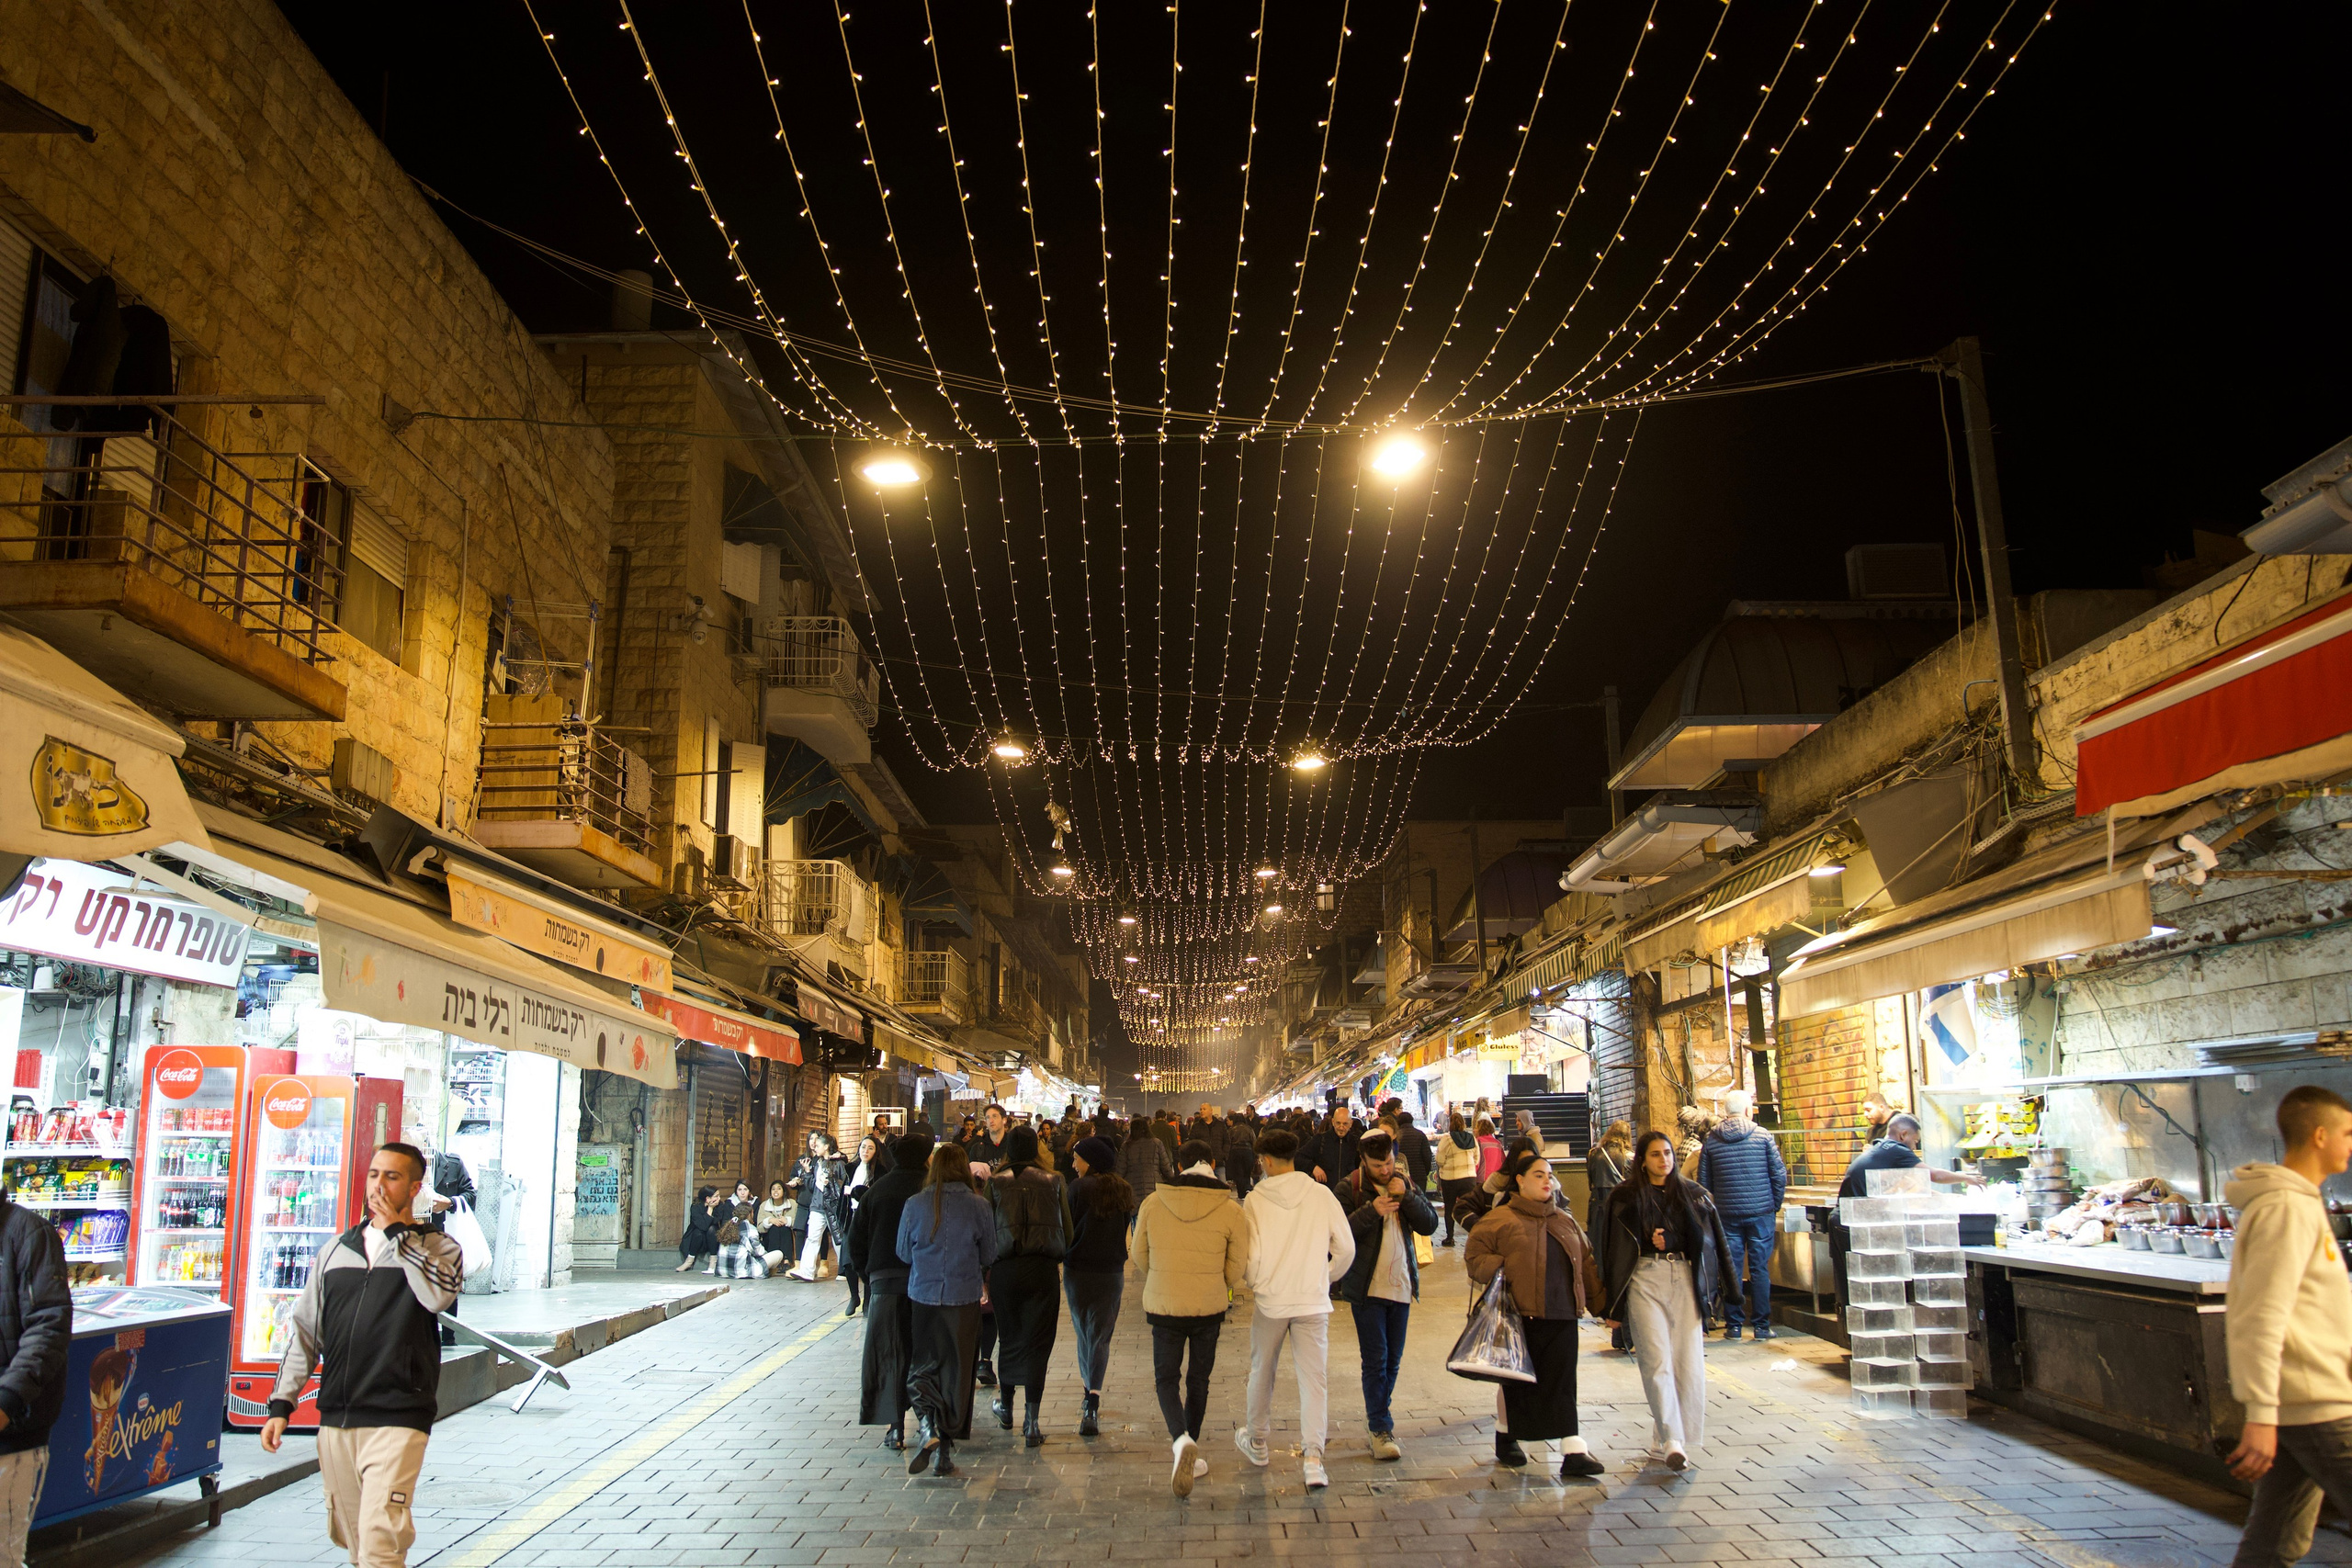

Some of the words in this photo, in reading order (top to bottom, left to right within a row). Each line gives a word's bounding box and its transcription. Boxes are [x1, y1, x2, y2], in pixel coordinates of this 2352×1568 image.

[92, 816, 100, 828] של
[7, 872, 63, 926] רק
[74, 888, 244, 966] סופרמרקט
[545, 918, 578, 948] בשמחות
[579, 931, 590, 953] רק
[442, 982, 477, 1029] בית
[483, 986, 510, 1036] כלי
[521, 995, 569, 1034] בשמחות
[571, 1010, 587, 1042] רק
[160, 1067, 199, 1082] Coca-Cola
[268, 1097, 308, 1112] Coca-Cola
